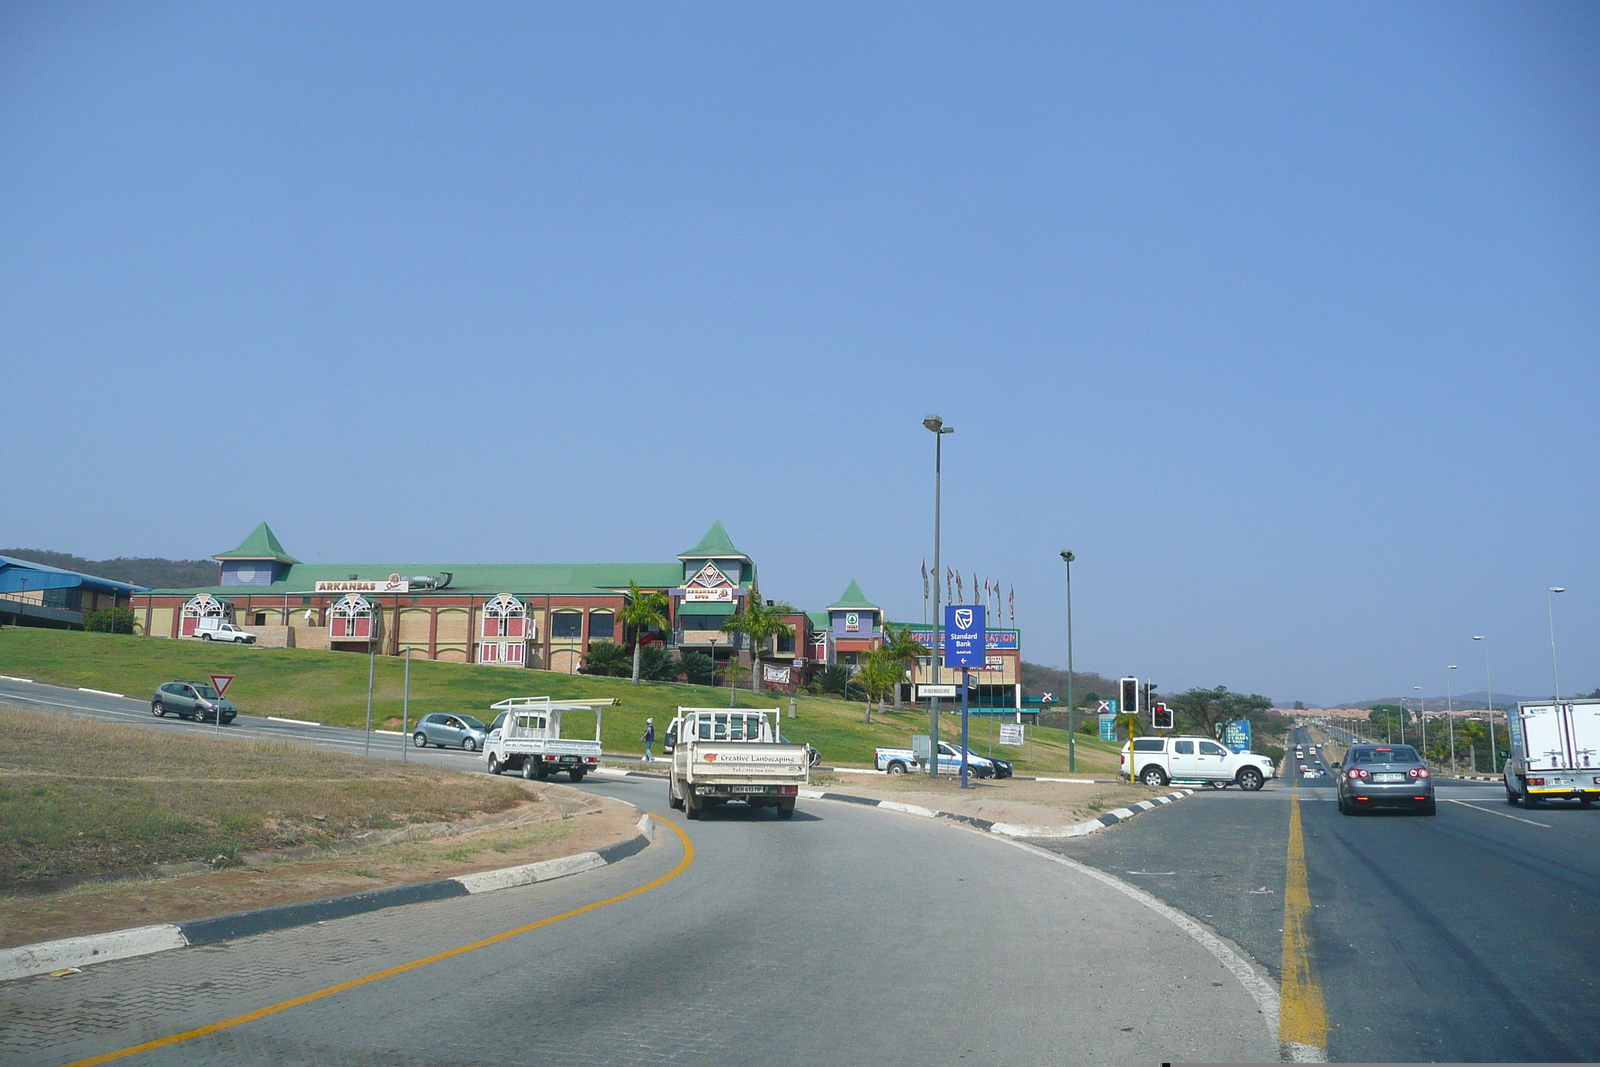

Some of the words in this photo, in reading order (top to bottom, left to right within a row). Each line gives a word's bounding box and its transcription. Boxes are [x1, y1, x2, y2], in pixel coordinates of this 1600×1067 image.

[318, 582, 376, 591] ARKANSAS
[720, 754, 749, 762] Creative
[751, 755, 795, 765] Landscaping
